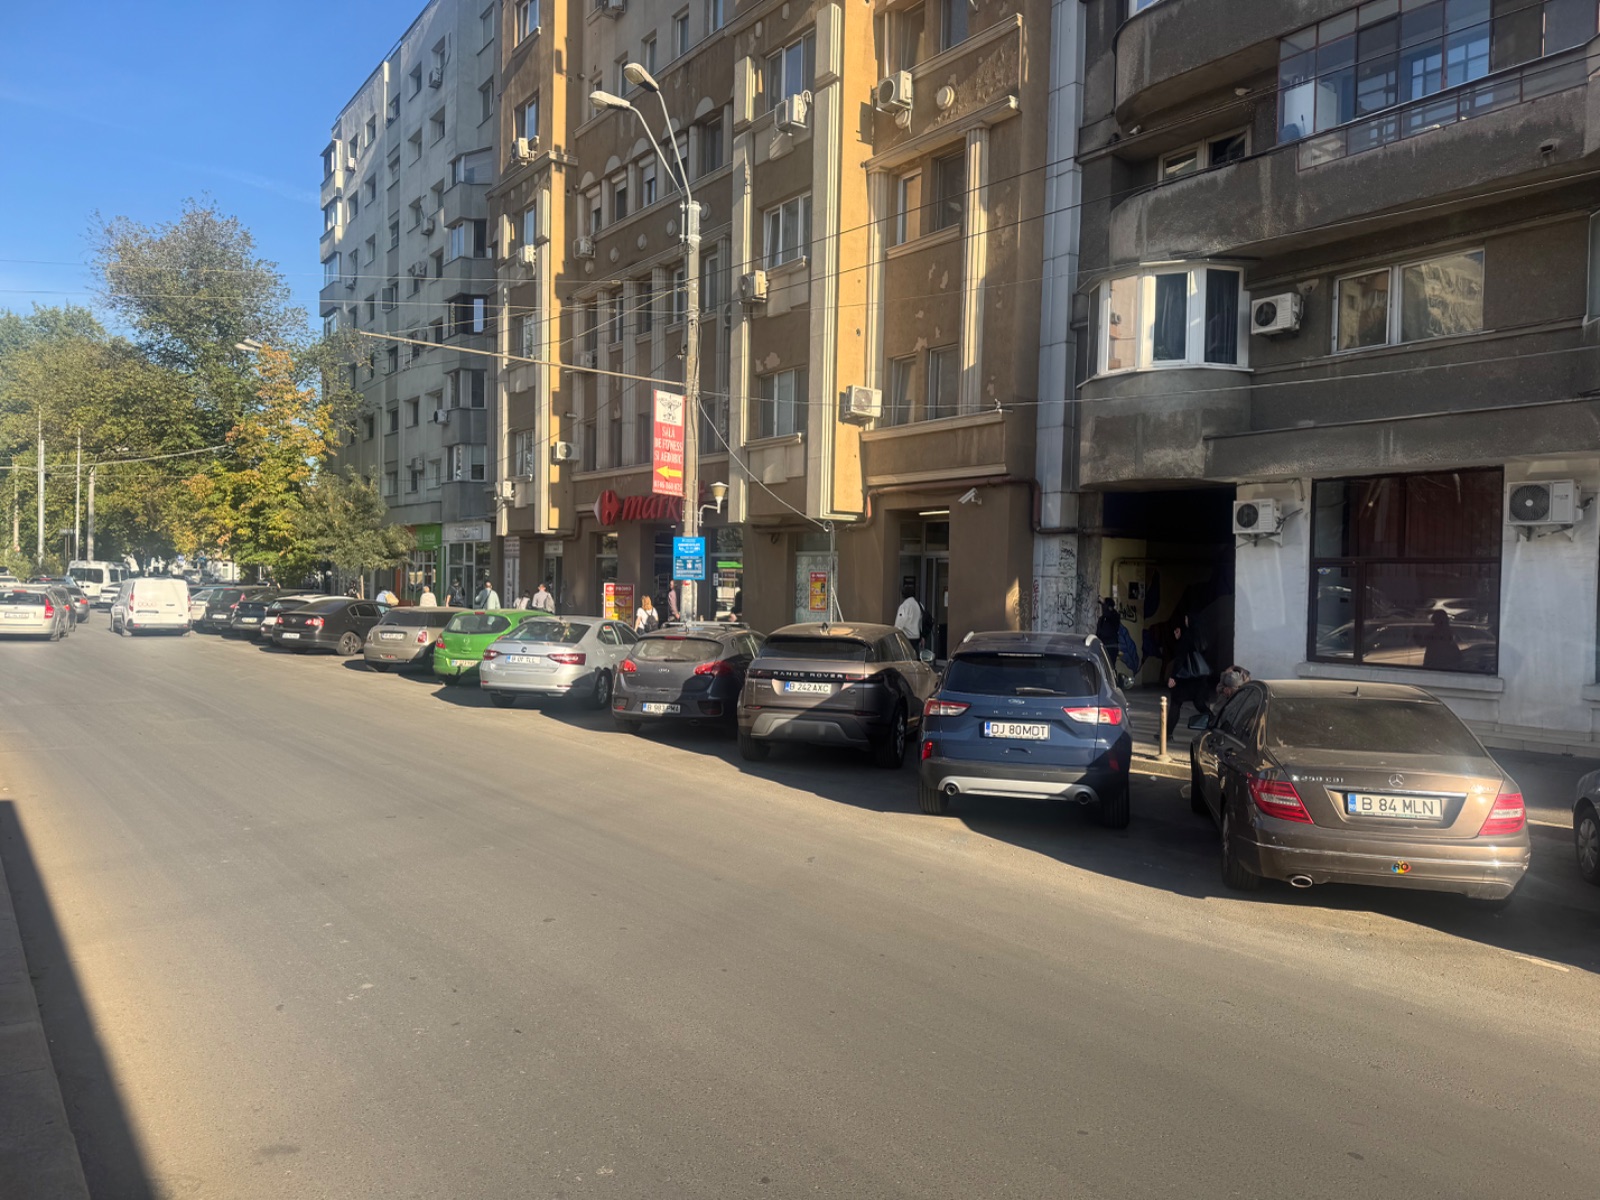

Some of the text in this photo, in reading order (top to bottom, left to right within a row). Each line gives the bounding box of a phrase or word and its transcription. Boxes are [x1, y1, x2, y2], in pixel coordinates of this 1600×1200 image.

[661, 426, 675, 438] SALA
[789, 682, 795, 690] B
[991, 724, 1005, 735] DJ
[1362, 797, 1372, 810] B
[1379, 798, 1397, 812] 84
[1402, 799, 1433, 815] MLN
[1393, 862, 1409, 870] RO
